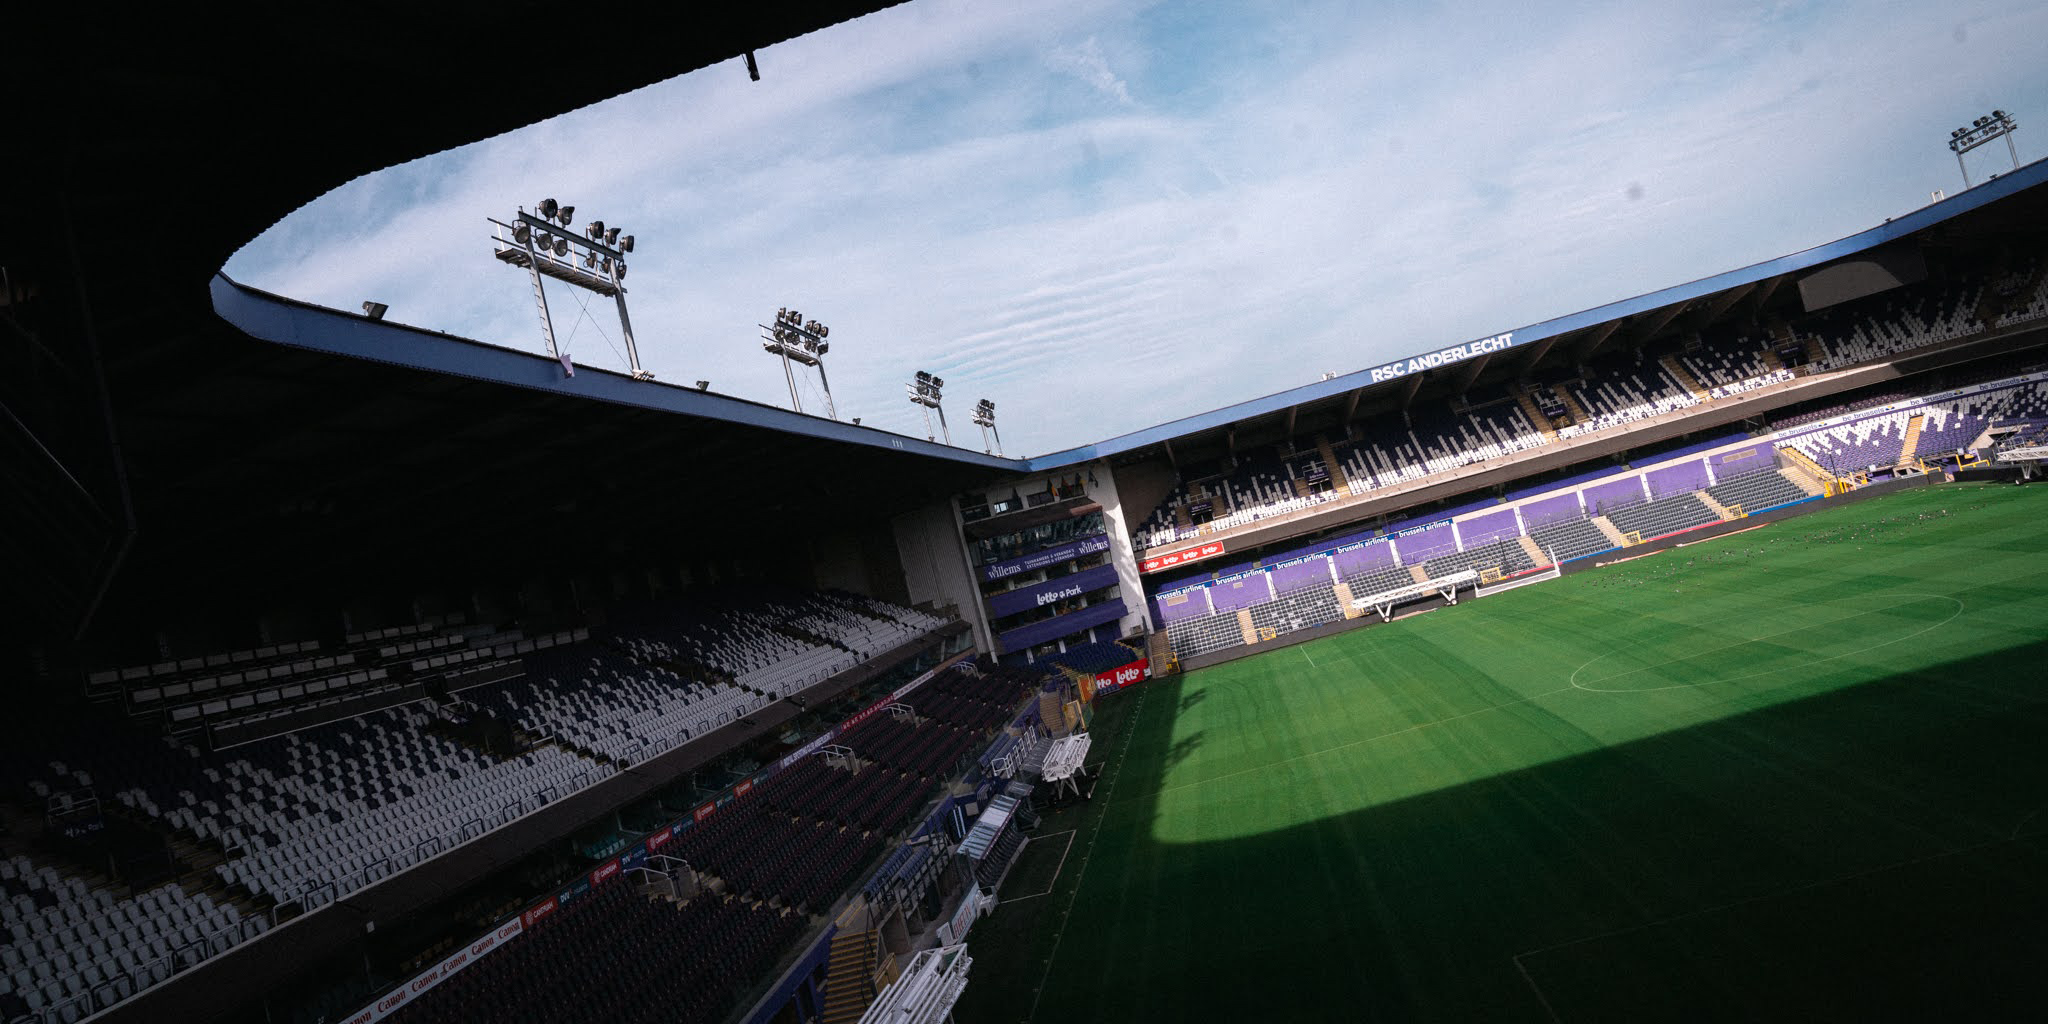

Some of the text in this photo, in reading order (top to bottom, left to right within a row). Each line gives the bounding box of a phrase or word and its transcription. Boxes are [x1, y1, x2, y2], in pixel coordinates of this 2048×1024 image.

[1370, 333, 1513, 382] RSC ANDERLECHT
[1399, 521, 1451, 539] brussels airlines
[1079, 540, 1109, 554] willems
[1337, 537, 1387, 554] brussels airlines
[1277, 552, 1327, 569] brussels airlines
[988, 564, 1021, 579] willems
[1216, 568, 1265, 585] brussels airlines
[1156, 583, 1204, 600] brussels airlines
[498, 921, 520, 939] Canon
[471, 936, 494, 955] Canon
[443, 953, 467, 973] Canon
[411, 971, 438, 992] Canon
[377, 990, 406, 1013] Canon
